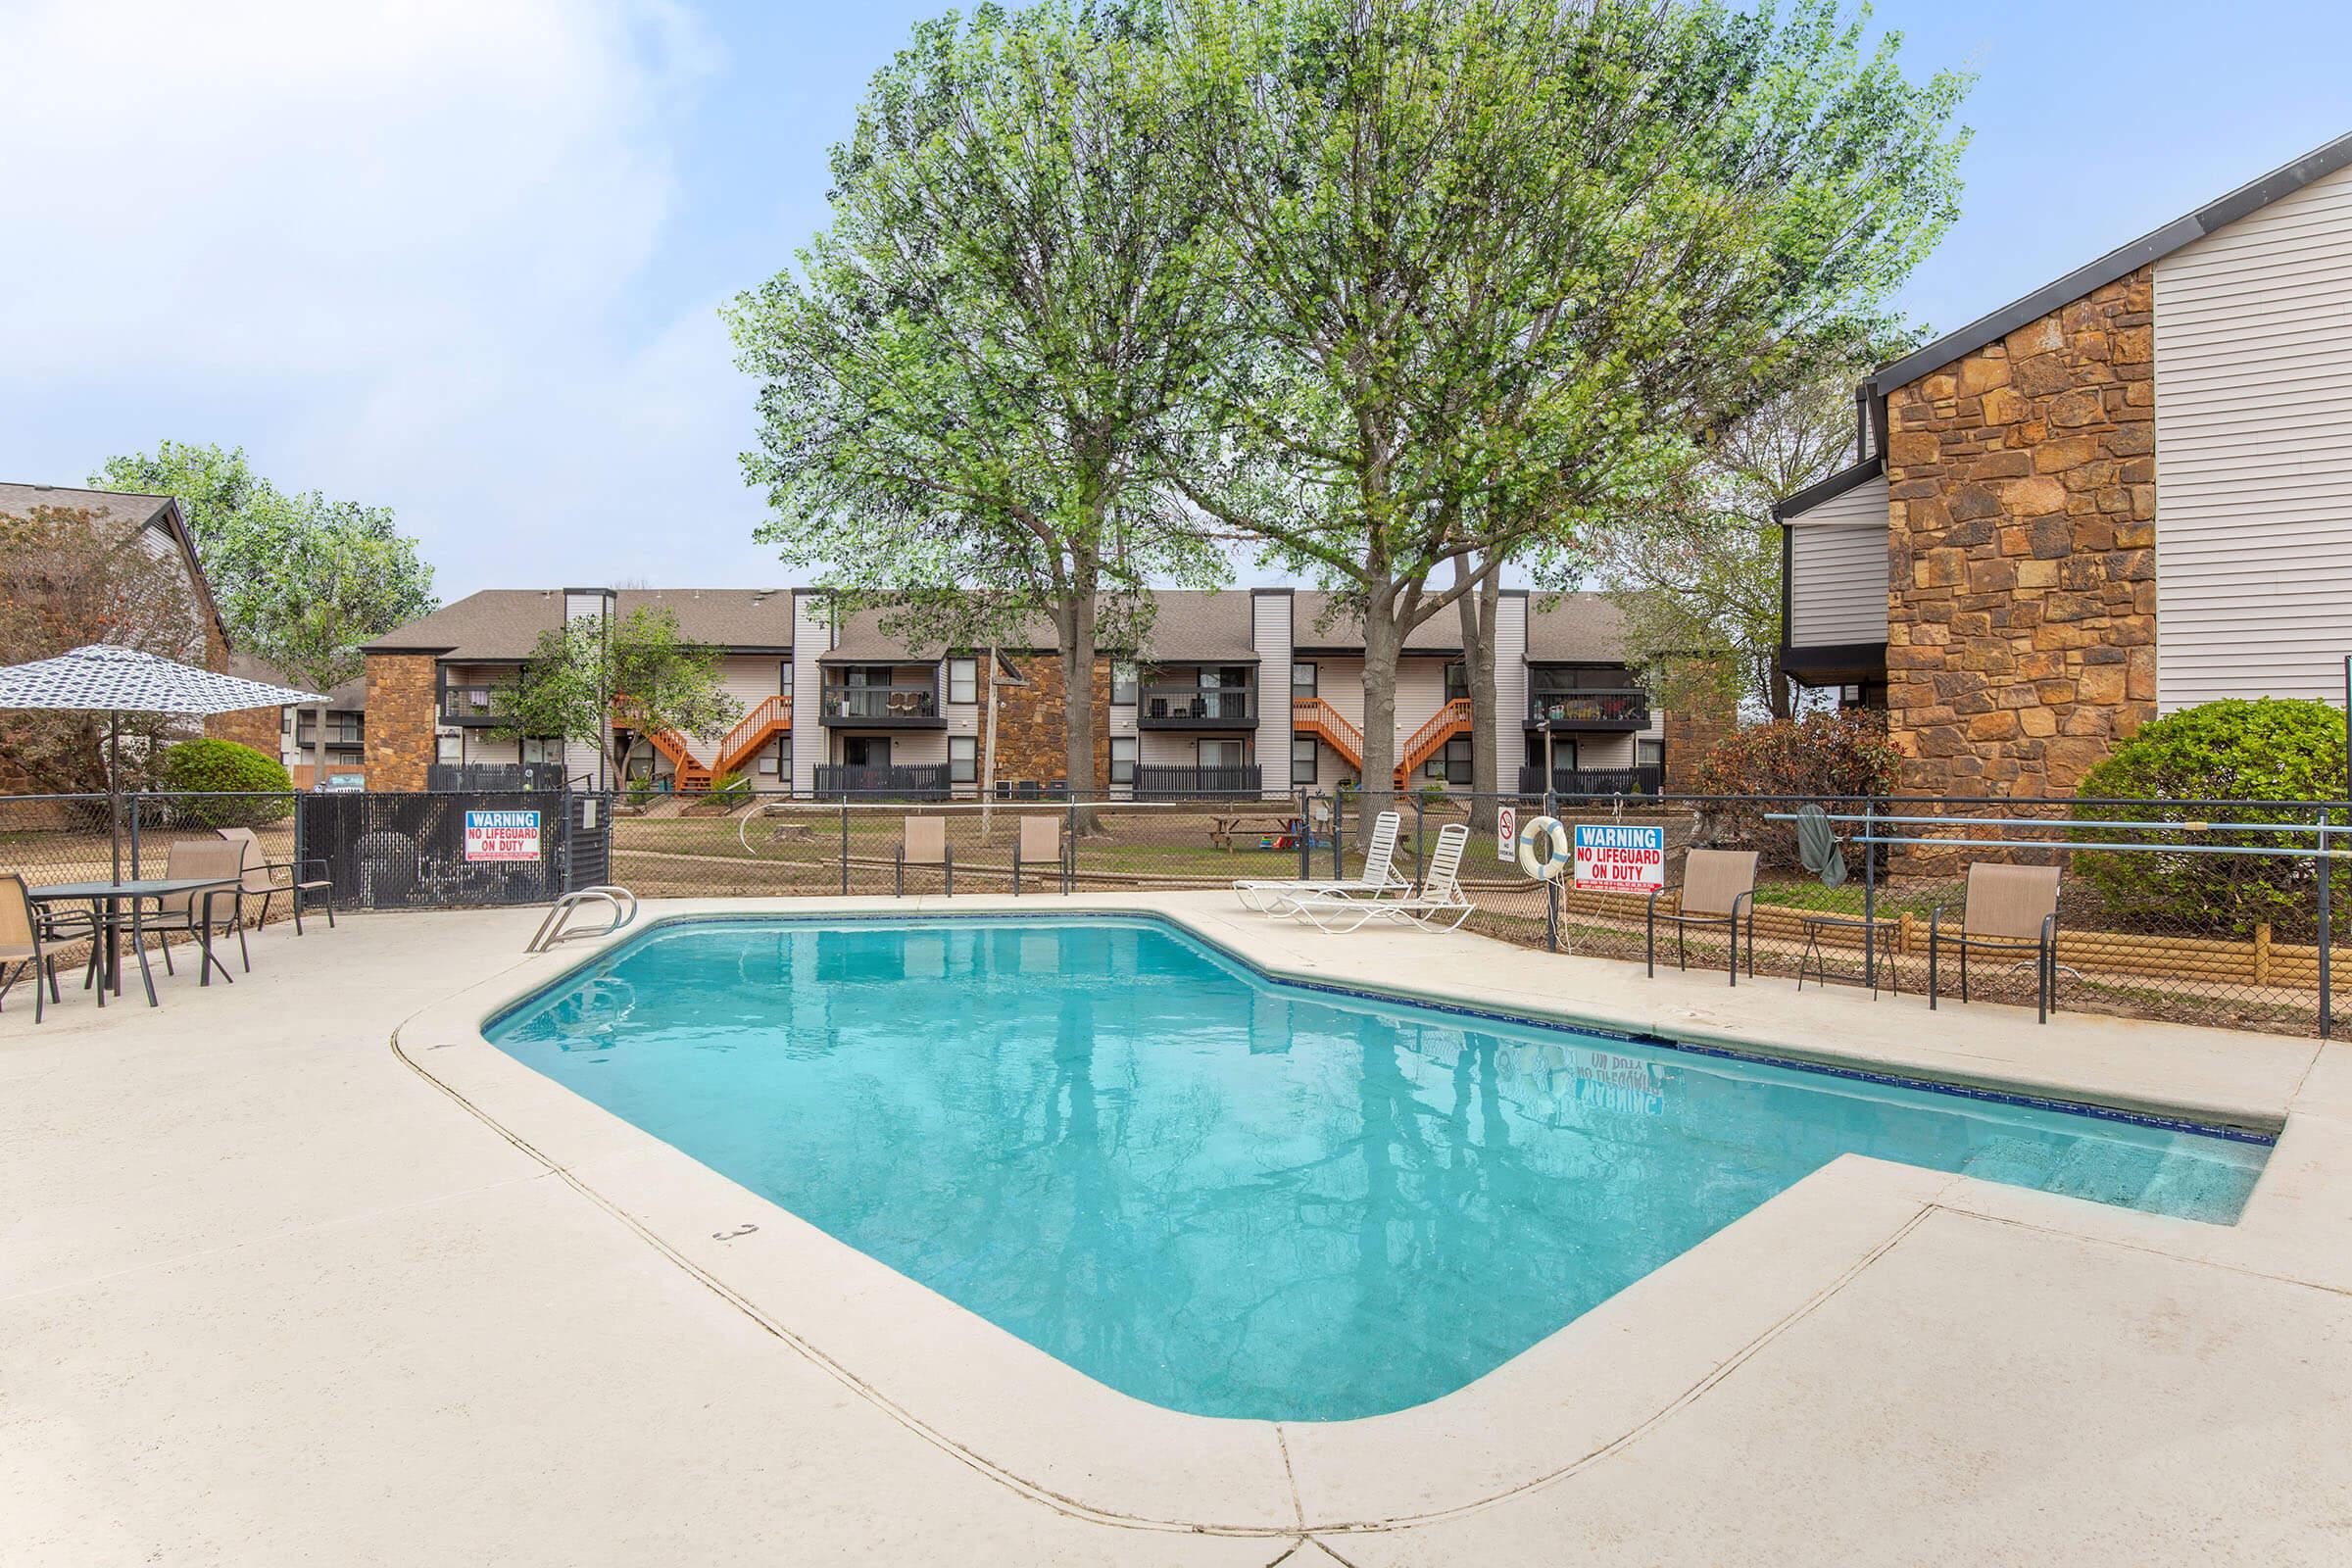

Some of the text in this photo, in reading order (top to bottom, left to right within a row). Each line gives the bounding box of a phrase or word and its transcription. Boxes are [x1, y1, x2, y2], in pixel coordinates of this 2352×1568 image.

[471, 812, 534, 827] WARNING
[468, 828, 538, 840] NO LIFEGUARD
[1582, 827, 1656, 849] WARNING
[481, 840, 524, 852] ON DUTY
[1577, 847, 1660, 865] NO LIFEGUARD
[1592, 863, 1643, 881] ON DUTY
